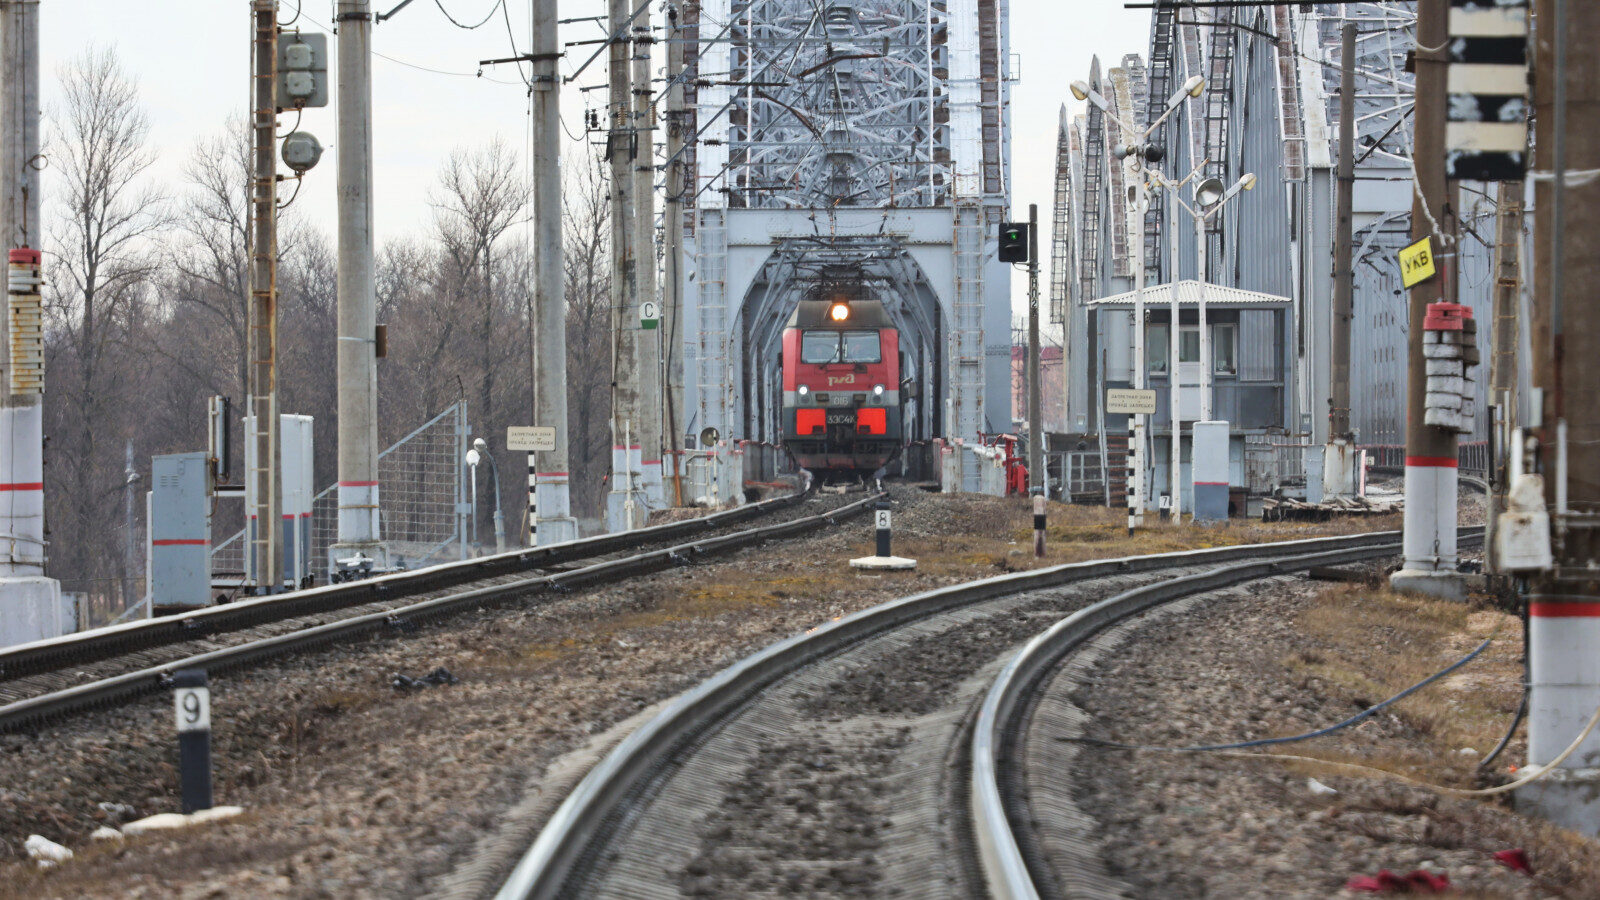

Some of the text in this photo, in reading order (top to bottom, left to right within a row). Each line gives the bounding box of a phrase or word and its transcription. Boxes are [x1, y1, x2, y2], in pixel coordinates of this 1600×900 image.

[1404, 250, 1429, 274] УКВ
[1162, 496, 1168, 506] 7
[879, 511, 887, 527] 8
[183, 692, 200, 724] 9
